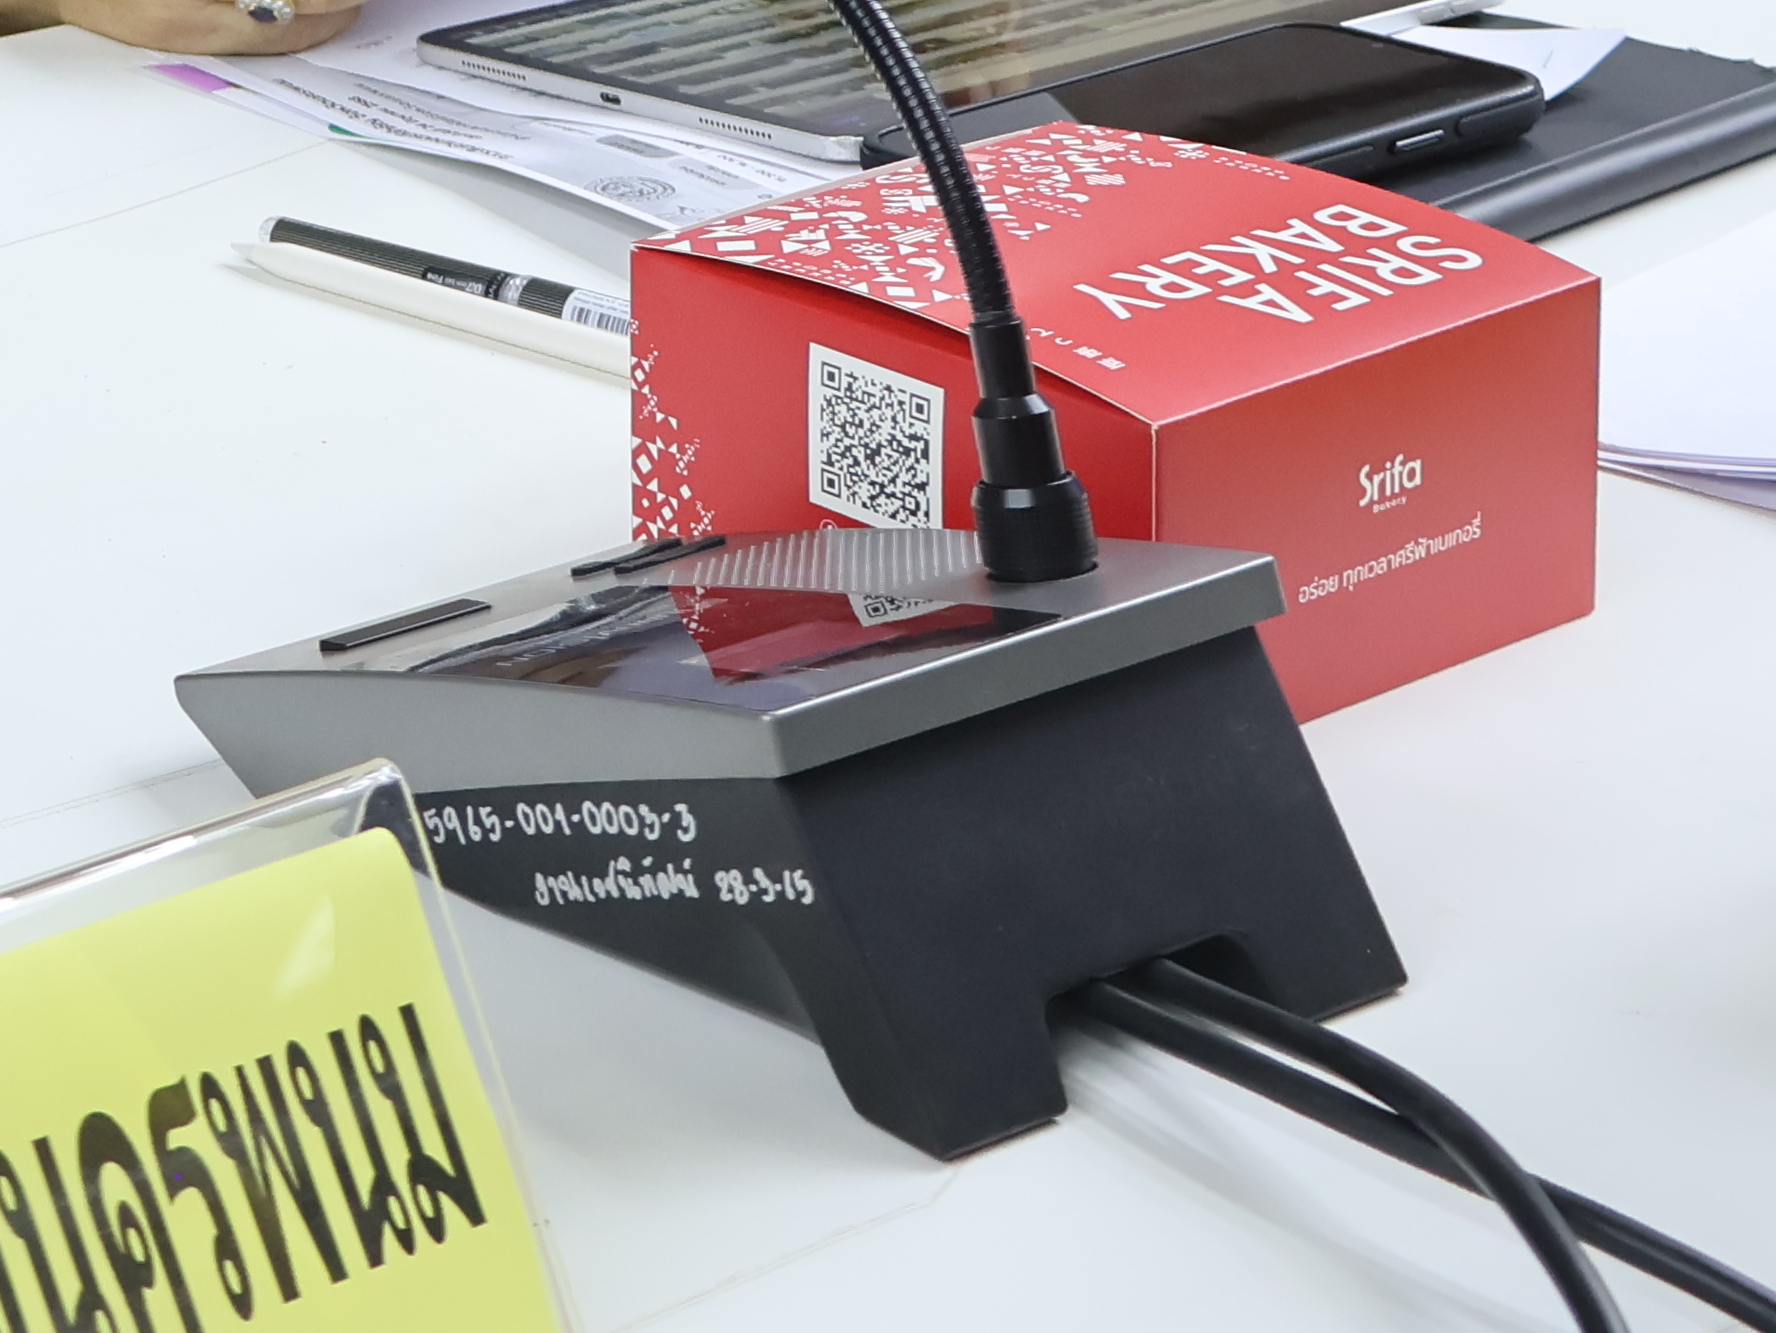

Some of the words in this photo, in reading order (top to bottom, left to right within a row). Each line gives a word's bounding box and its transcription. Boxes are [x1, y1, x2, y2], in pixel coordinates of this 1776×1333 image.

[1072, 203, 1410, 321] BAKERY
[1215, 235, 1485, 324] SRIFA
[1358, 453, 1422, 508] Srifa
[1298, 573, 1340, 603] อร่อย
